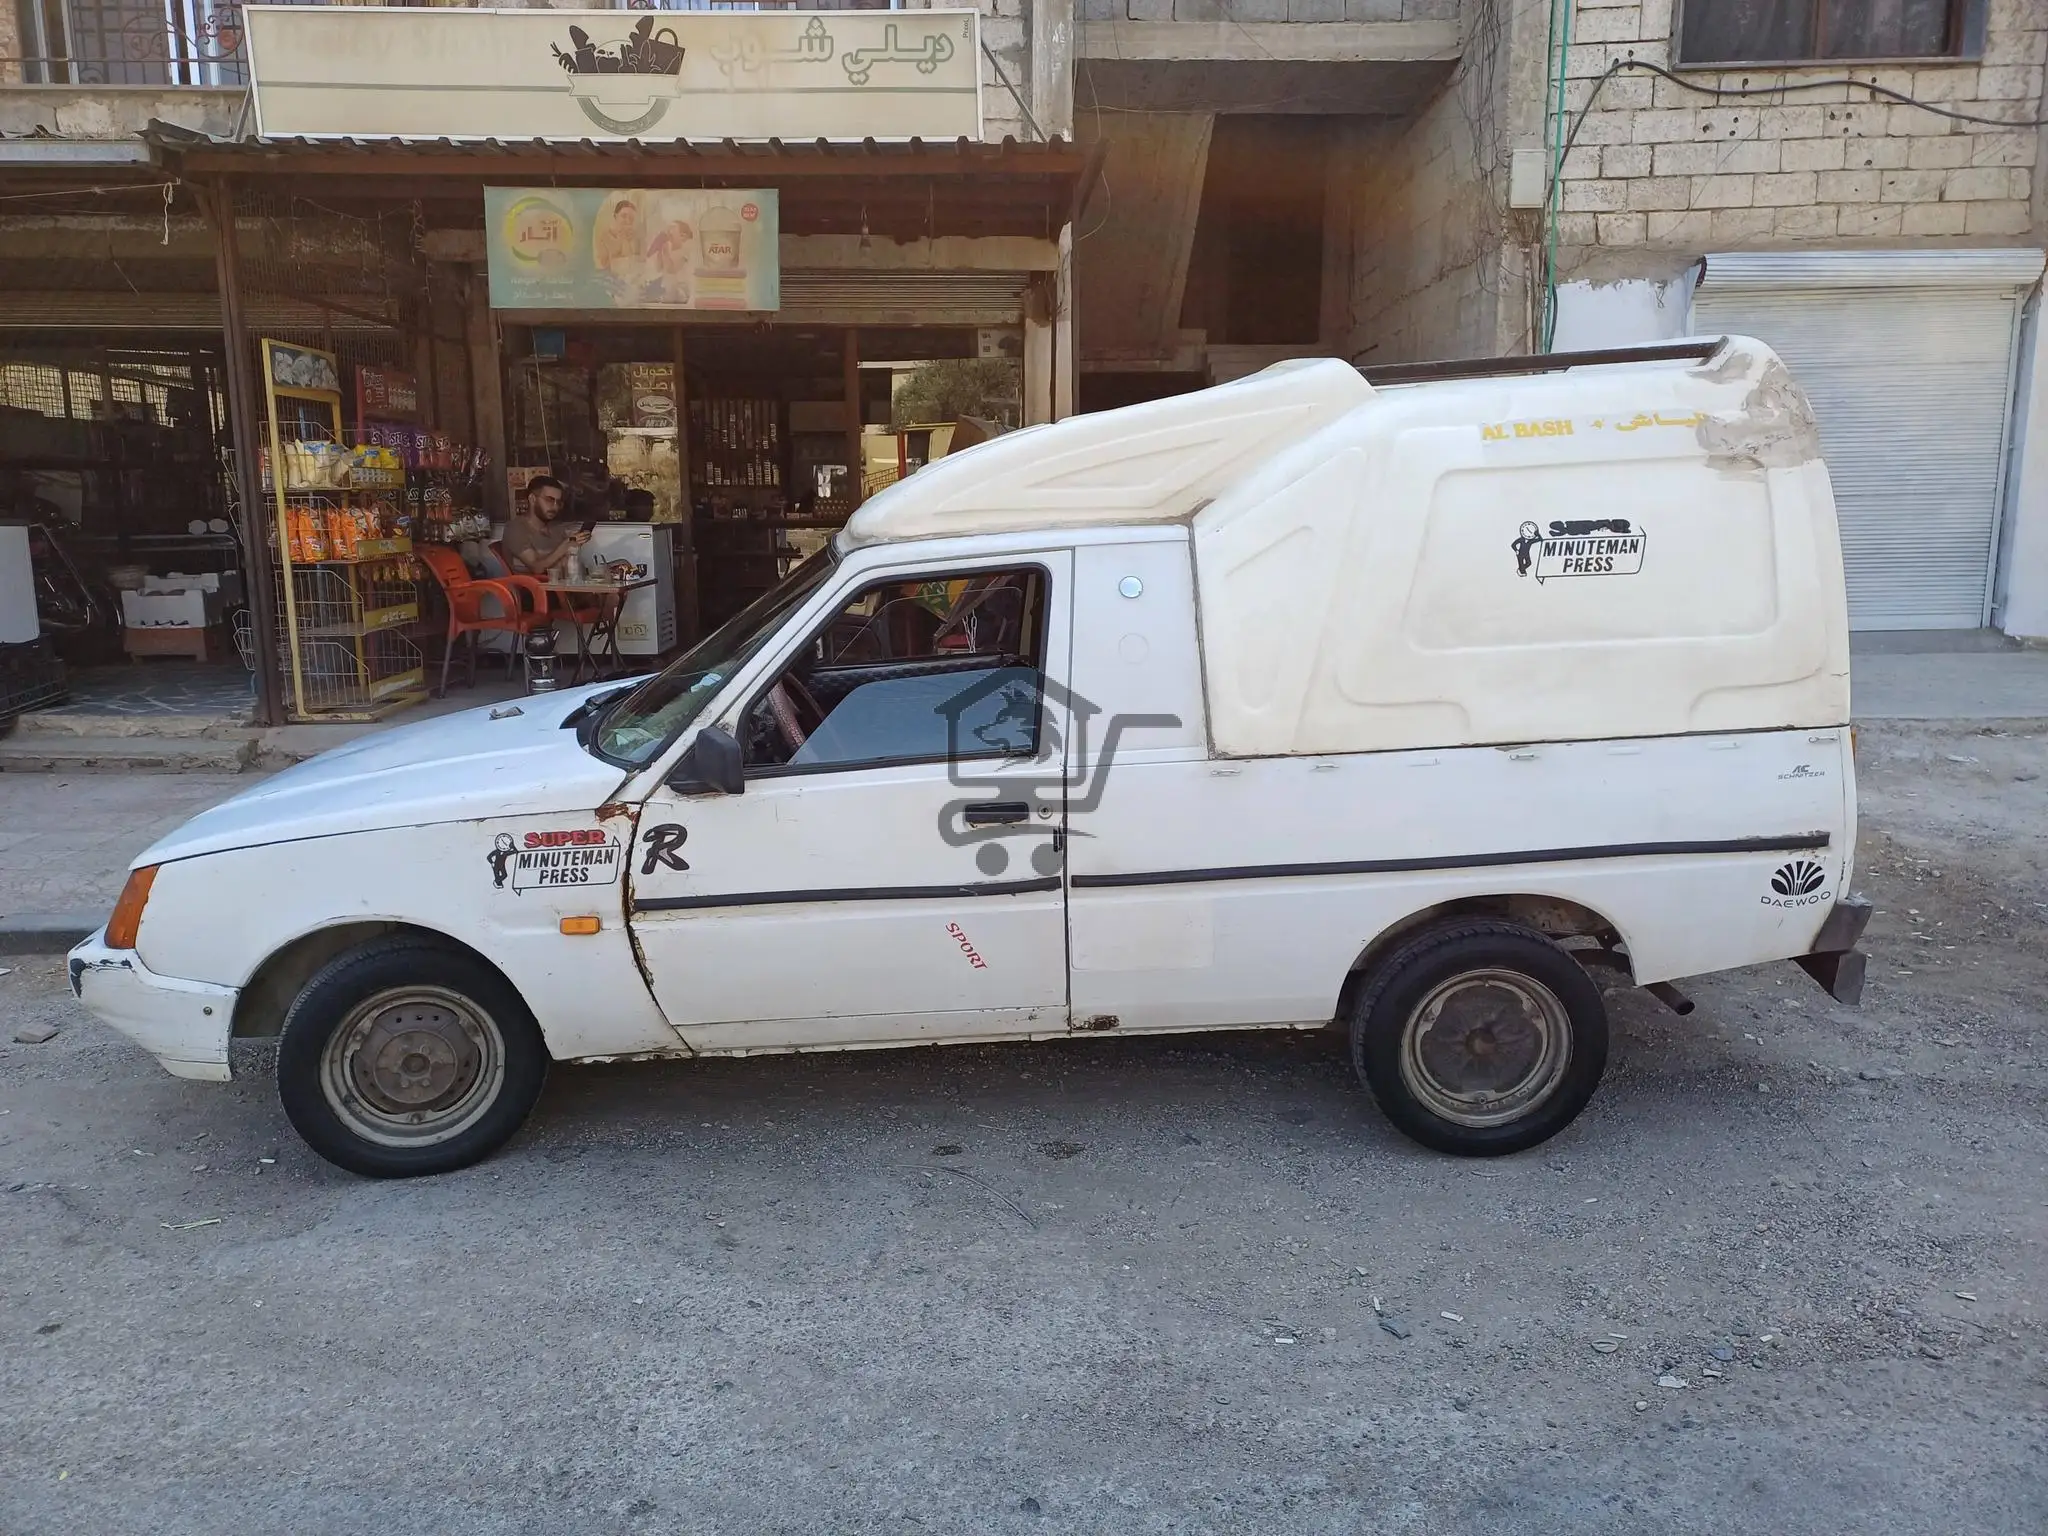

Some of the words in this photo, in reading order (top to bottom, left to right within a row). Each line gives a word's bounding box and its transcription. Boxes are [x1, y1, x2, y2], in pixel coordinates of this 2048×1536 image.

[842, 23, 955, 85] ديلي
[1482, 422, 1510, 440] AL
[1514, 419, 1574, 438] BASH
[1543, 538, 1640, 557] MINUTEMAN
[1562, 556, 1614, 573] PRESS
[524, 830, 606, 848] SUPER
[641, 823, 690, 875] R
[518, 849, 614, 869] MINUTEMAN
[539, 867, 589, 885] PRESS
[1760, 891, 1831, 908] DAEWOO
[945, 922, 988, 969] SPORT
